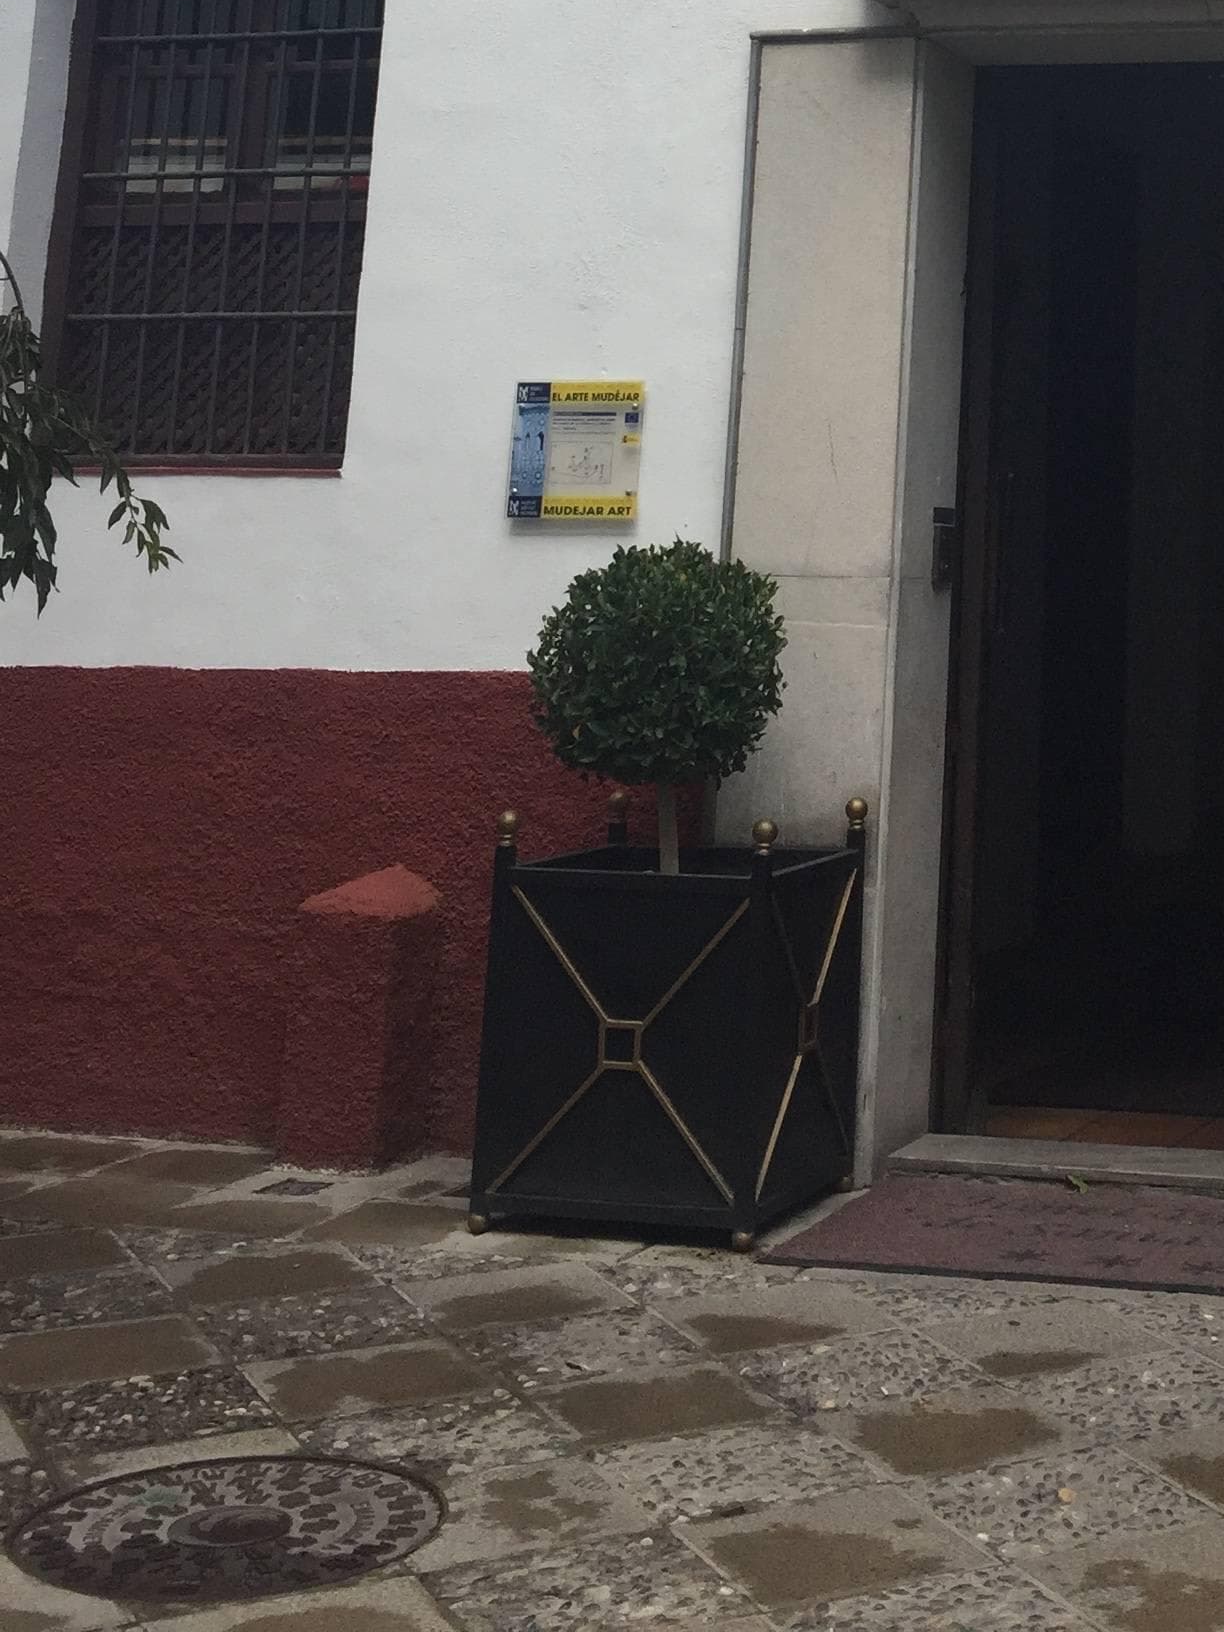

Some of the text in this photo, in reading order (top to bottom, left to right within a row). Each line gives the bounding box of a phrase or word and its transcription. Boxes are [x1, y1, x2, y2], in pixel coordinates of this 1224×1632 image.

[551, 392, 563, 402] EL
[565, 392, 589, 402] ARTE
[591, 388, 640, 402] MUDÉJAR
[543, 506, 603, 516] MUDEJAR
[607, 506, 632, 516] ART
